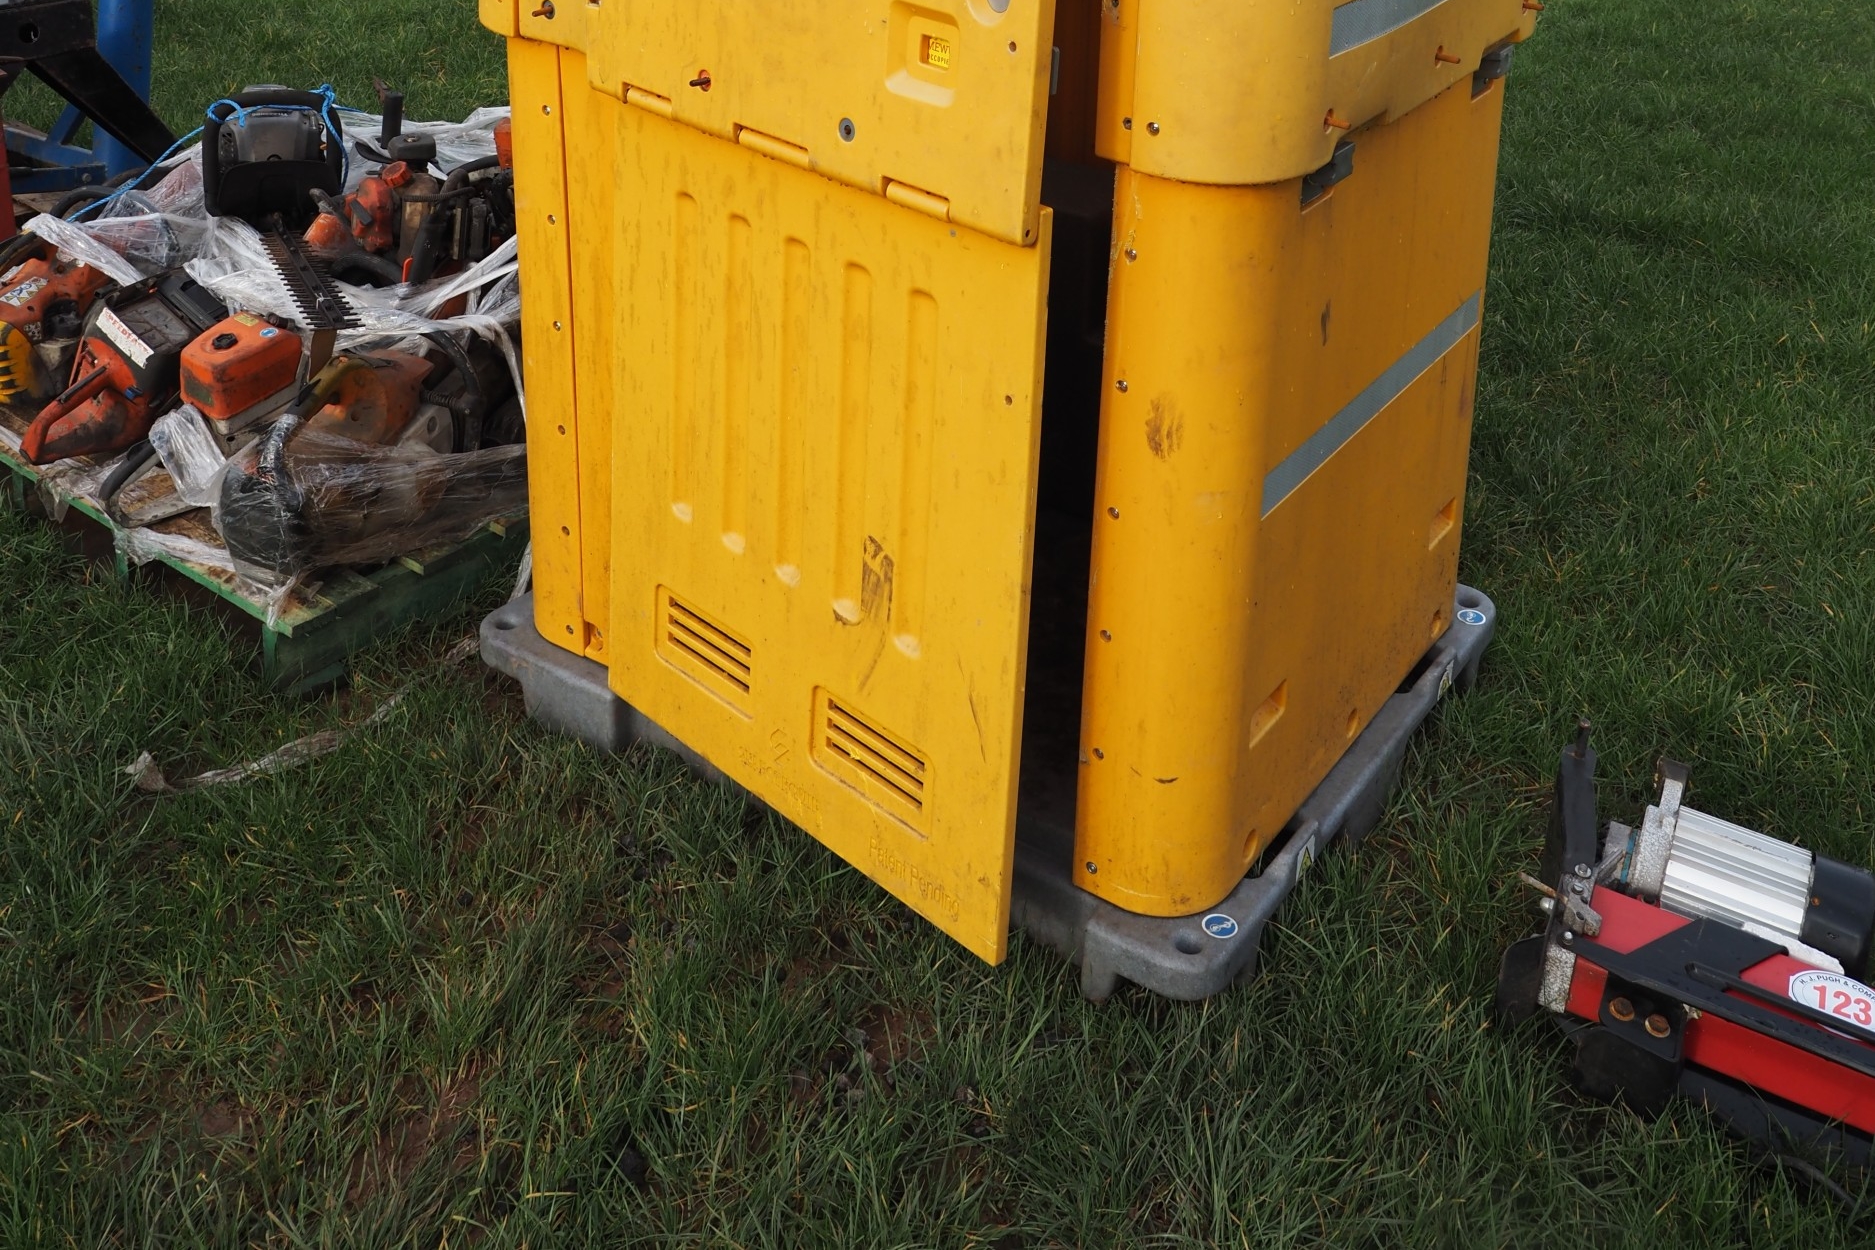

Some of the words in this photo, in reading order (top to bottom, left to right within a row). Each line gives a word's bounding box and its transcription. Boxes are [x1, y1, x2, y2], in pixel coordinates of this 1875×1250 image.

[868, 836, 906, 882] Patent
[909, 863, 960, 923] Pending
[1816, 975, 1841, 984] PUGH
[1813, 985, 1873, 1026] 123
